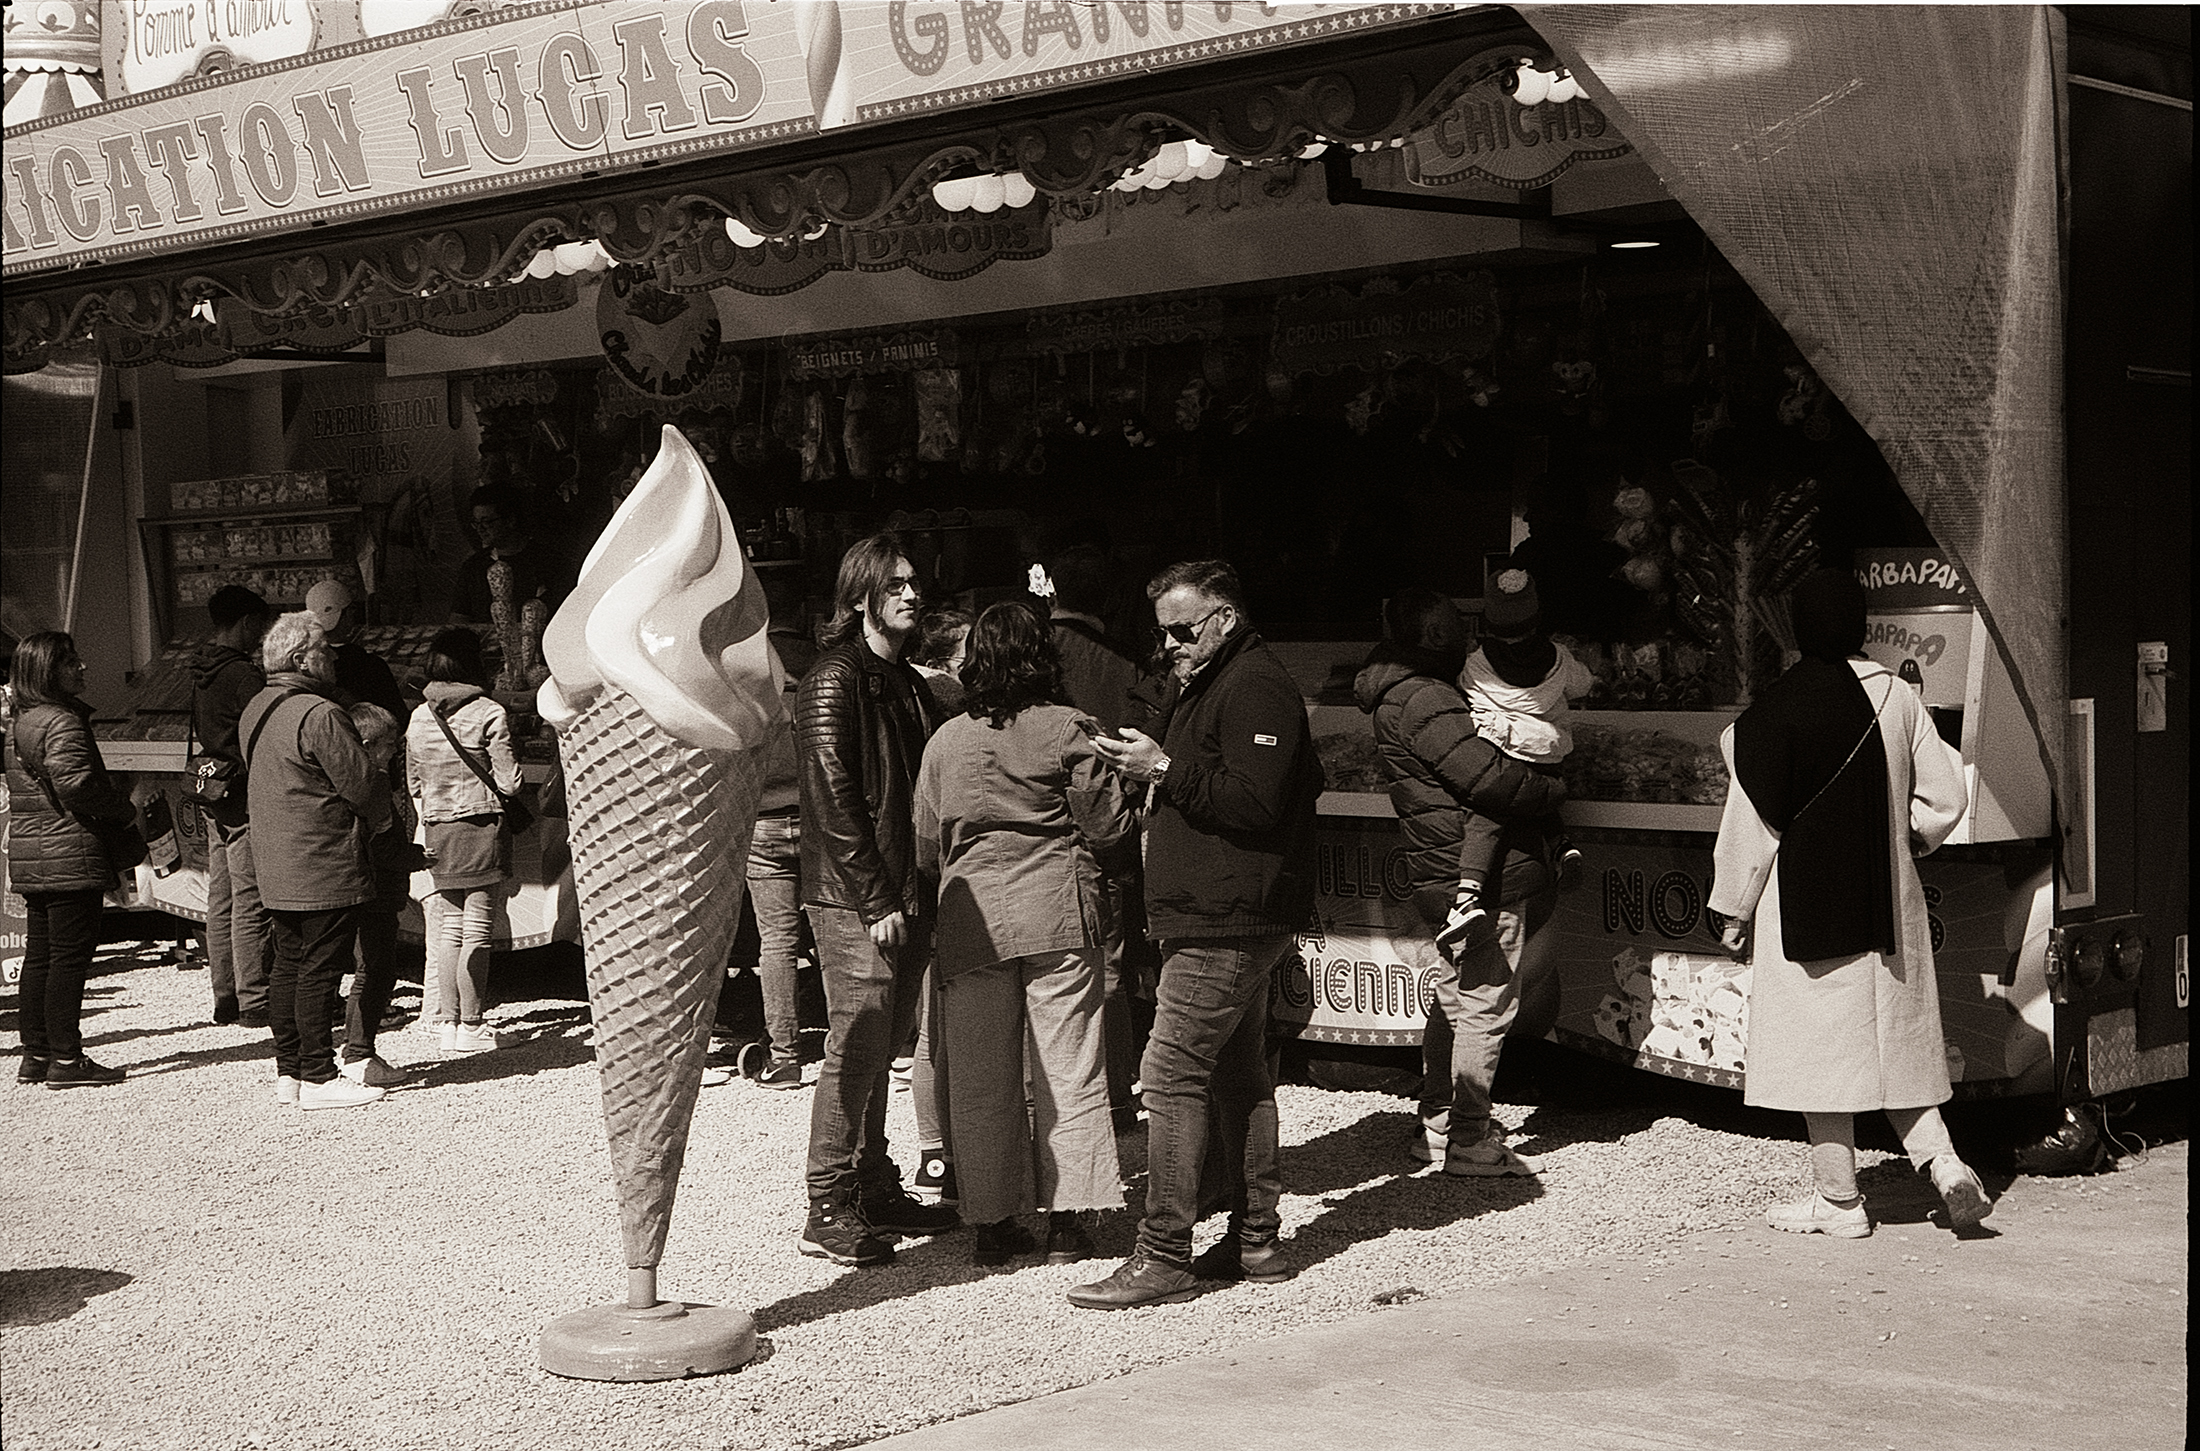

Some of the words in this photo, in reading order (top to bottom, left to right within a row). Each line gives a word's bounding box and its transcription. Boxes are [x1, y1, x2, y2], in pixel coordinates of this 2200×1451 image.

[133, 0, 197, 65] Pomme
[206, 0, 293, 42] damour
[396, 0, 767, 179] LUCAS
[1435, 97, 1607, 159] CHICHIS
[866, 223, 1030, 260] D'AMOURS
[1286, 314, 1404, 347] CROUSTILLONS
[1417, 304, 1486, 333] CHICHIS
[799, 349, 864, 370] BEIGNETS
[313, 397, 439, 438] FABRICATION
[351, 442, 410, 476] LUCAS
